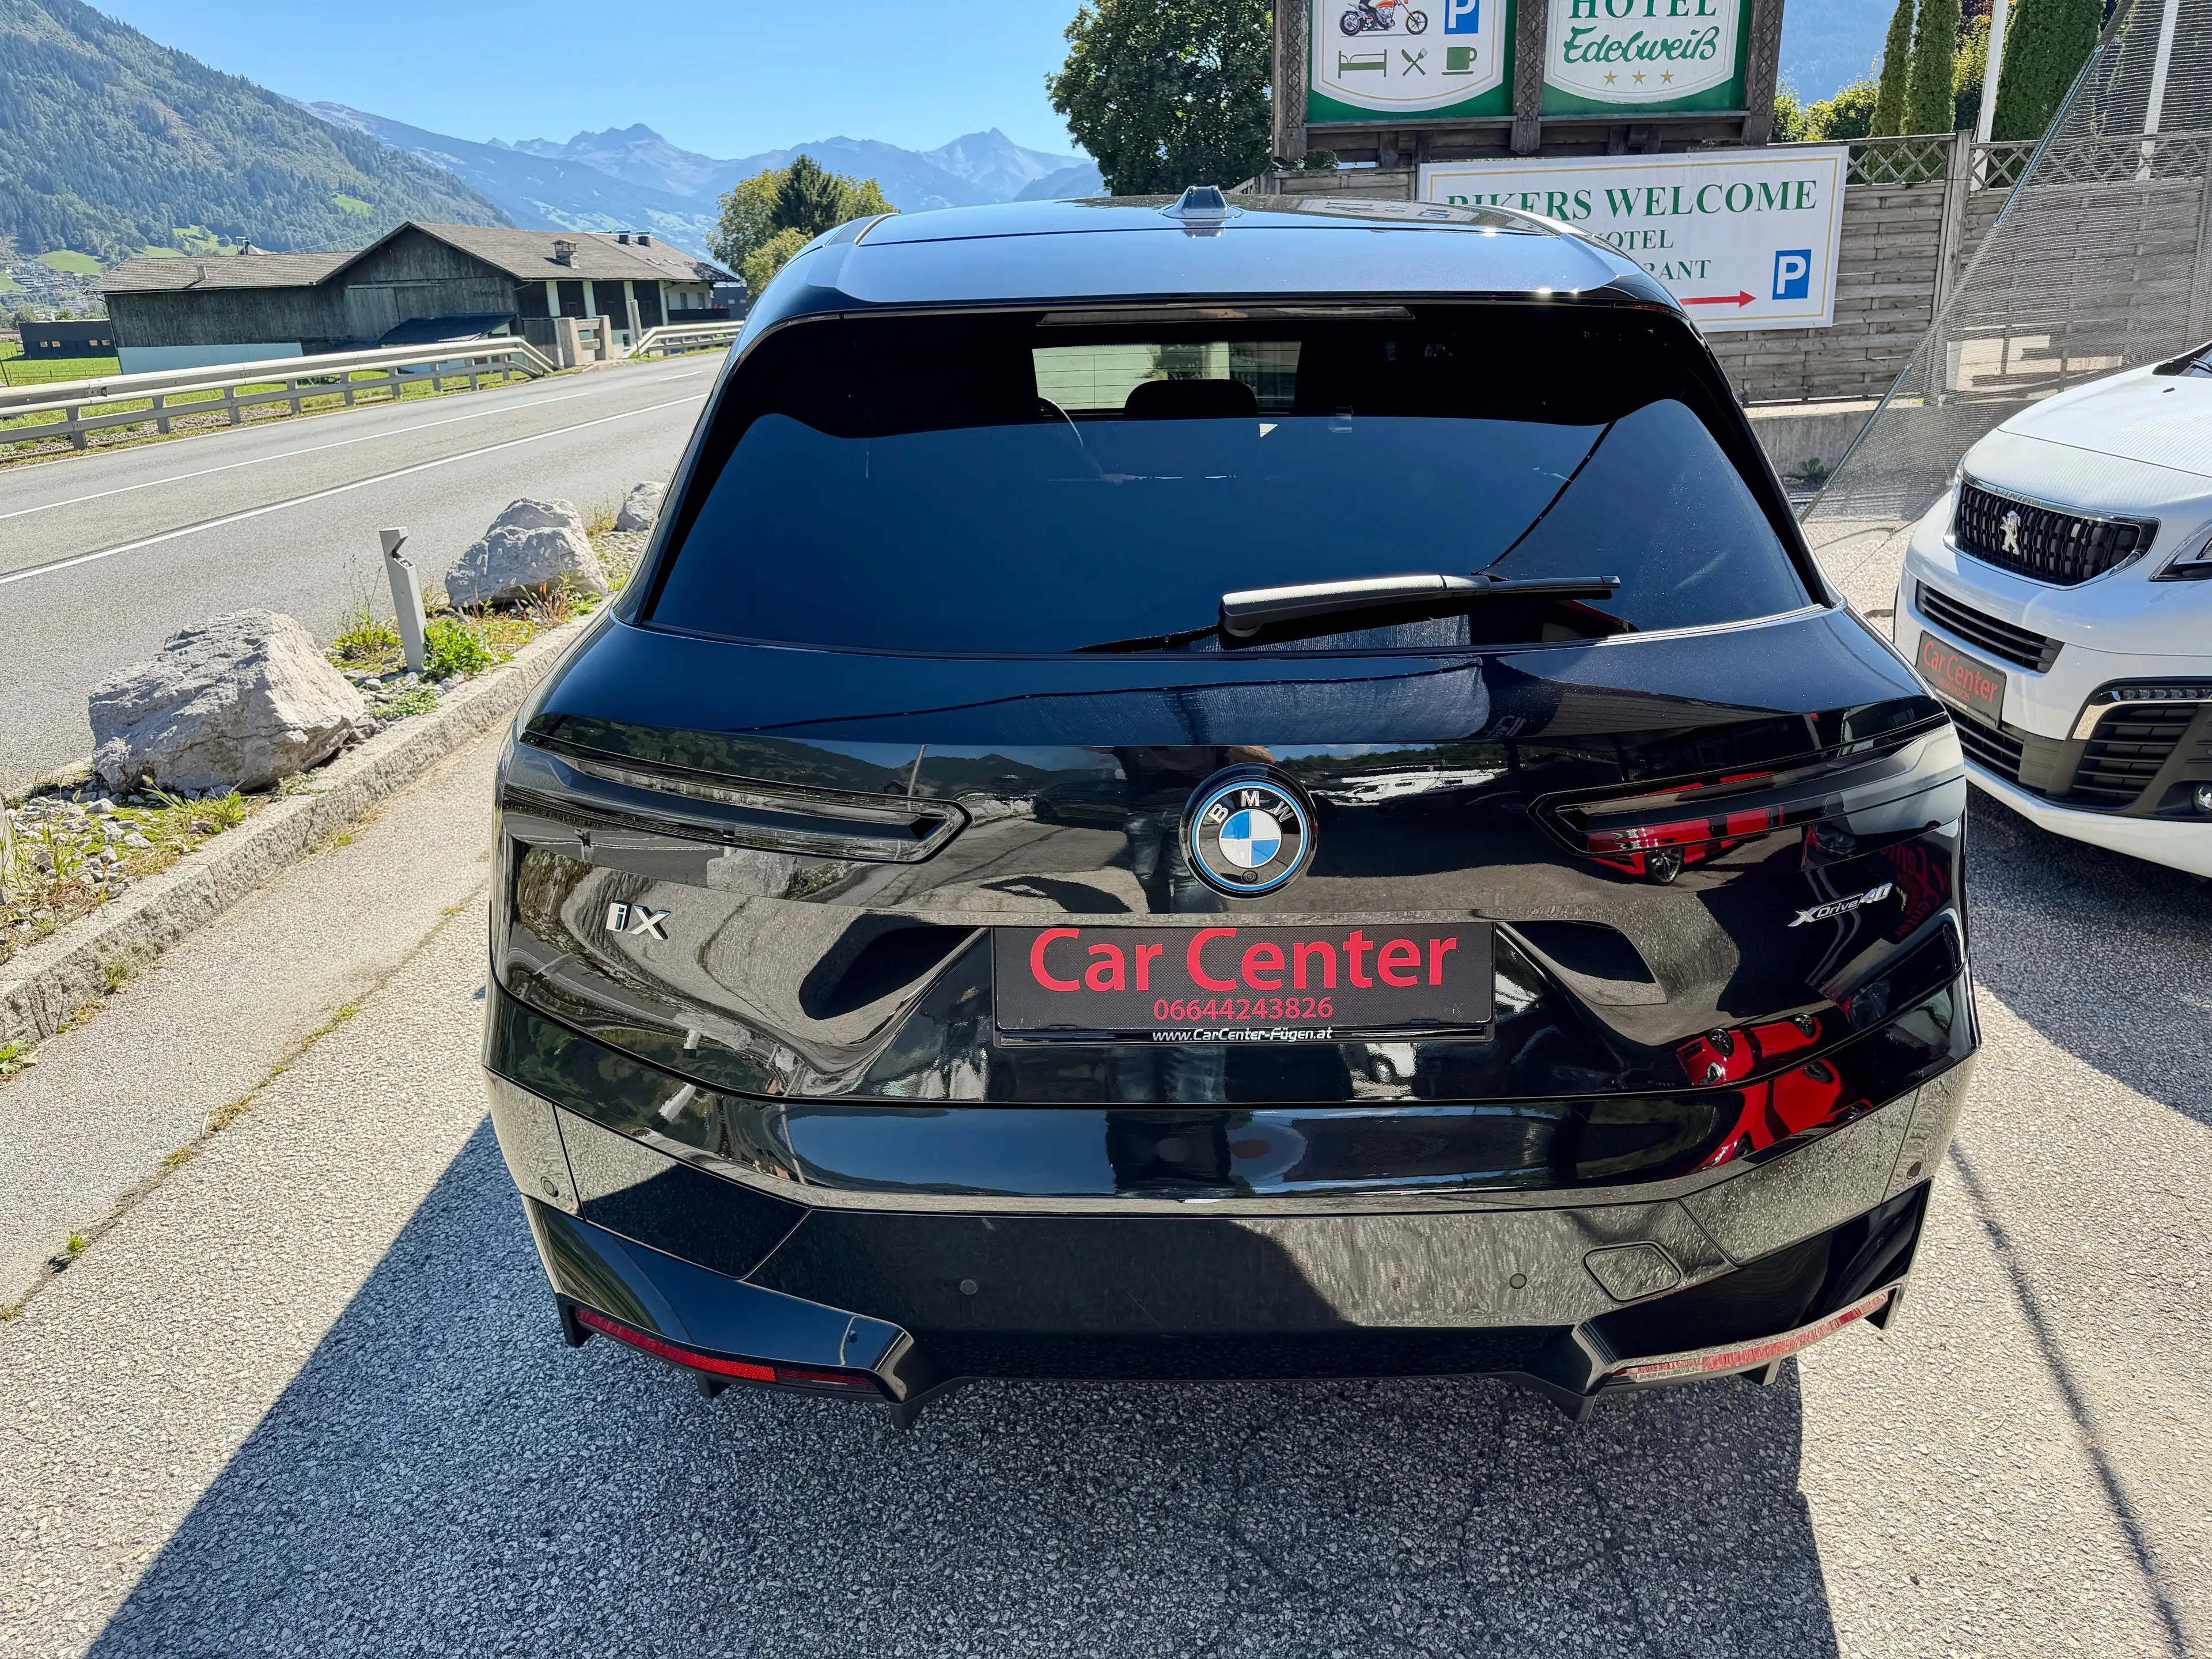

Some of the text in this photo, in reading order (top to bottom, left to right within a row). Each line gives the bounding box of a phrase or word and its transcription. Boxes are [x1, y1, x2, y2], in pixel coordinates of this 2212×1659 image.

[1563, 26, 1720, 64] Edelweiß
[1604, 180, 1817, 218] WELCOME
[1599, 230, 1674, 252] OTEL
[1923, 641, 1945, 673] Car
[1946, 654, 1998, 702] Center
[1208, 790, 1294, 824] BMW
[1030, 927, 1457, 992] Car Center
[1153, 997, 1334, 1021] 06644243826
[1152, 1027, 1333, 1043] www.CarCenter-Fügen.at
